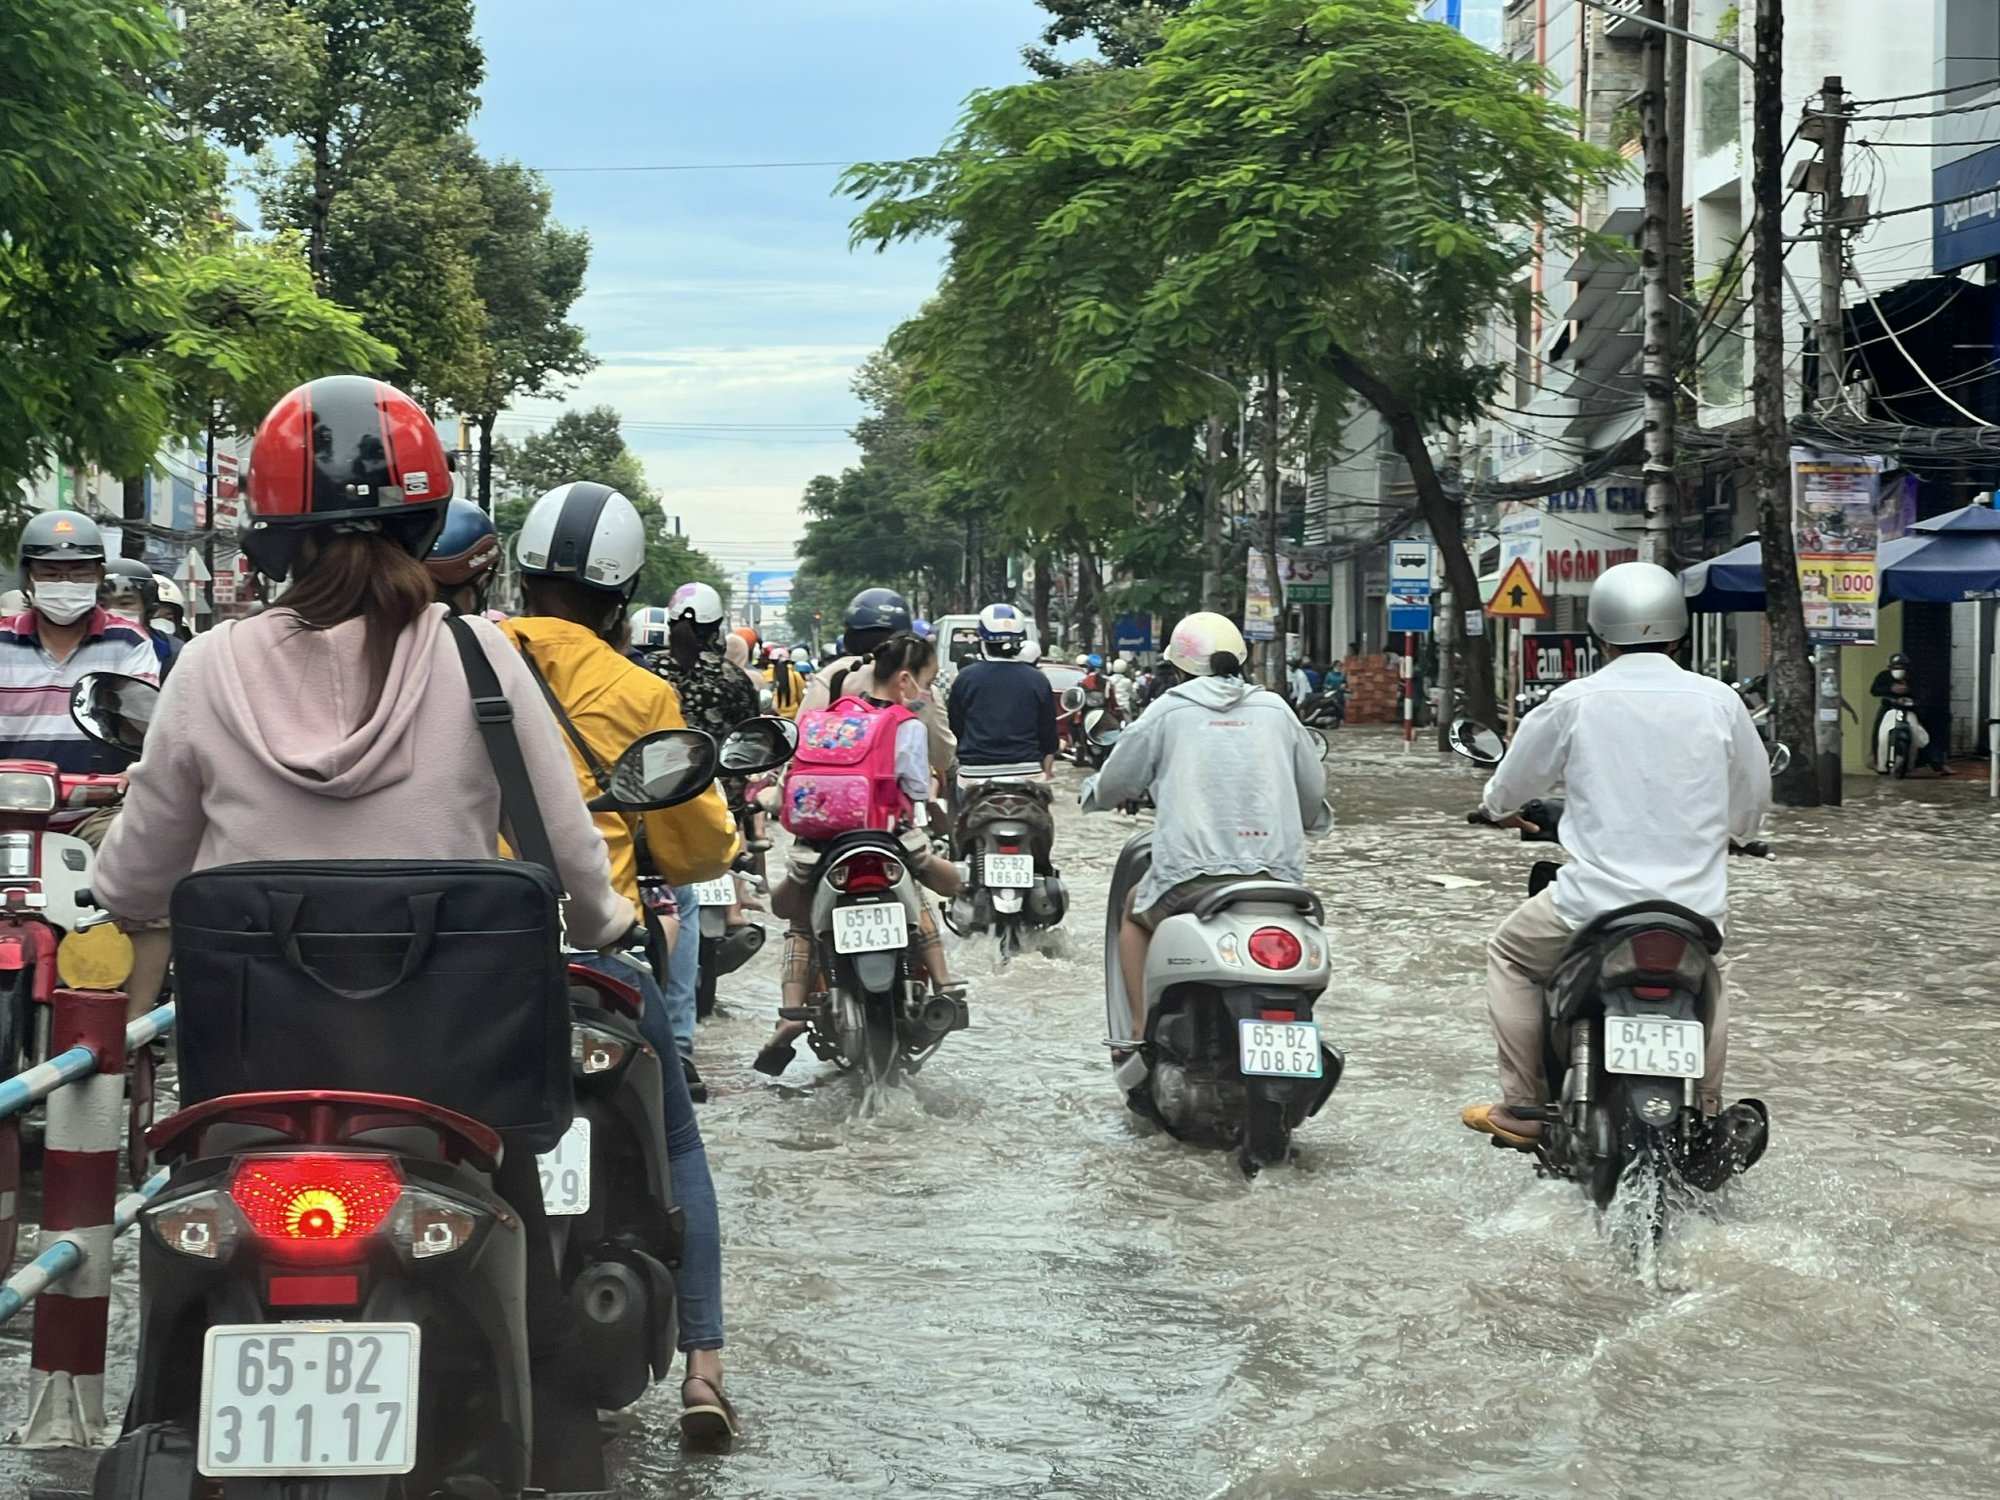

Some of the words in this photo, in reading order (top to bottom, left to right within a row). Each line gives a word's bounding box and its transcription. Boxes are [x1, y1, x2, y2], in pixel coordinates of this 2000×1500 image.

[992, 857, 1025, 871] 65-B2
[846, 907, 892, 928] 65-B1
[841, 927, 901, 949] 434.31
[1253, 1025, 1307, 1049] 65-B2
[1622, 1023, 1685, 1048] 64-F1
[1247, 1049, 1317, 1073] 708.62
[1611, 1047, 1696, 1074] 214.59
[237, 1336, 382, 1397] 65-B2
[214, 1401, 401, 1464] 311.17
